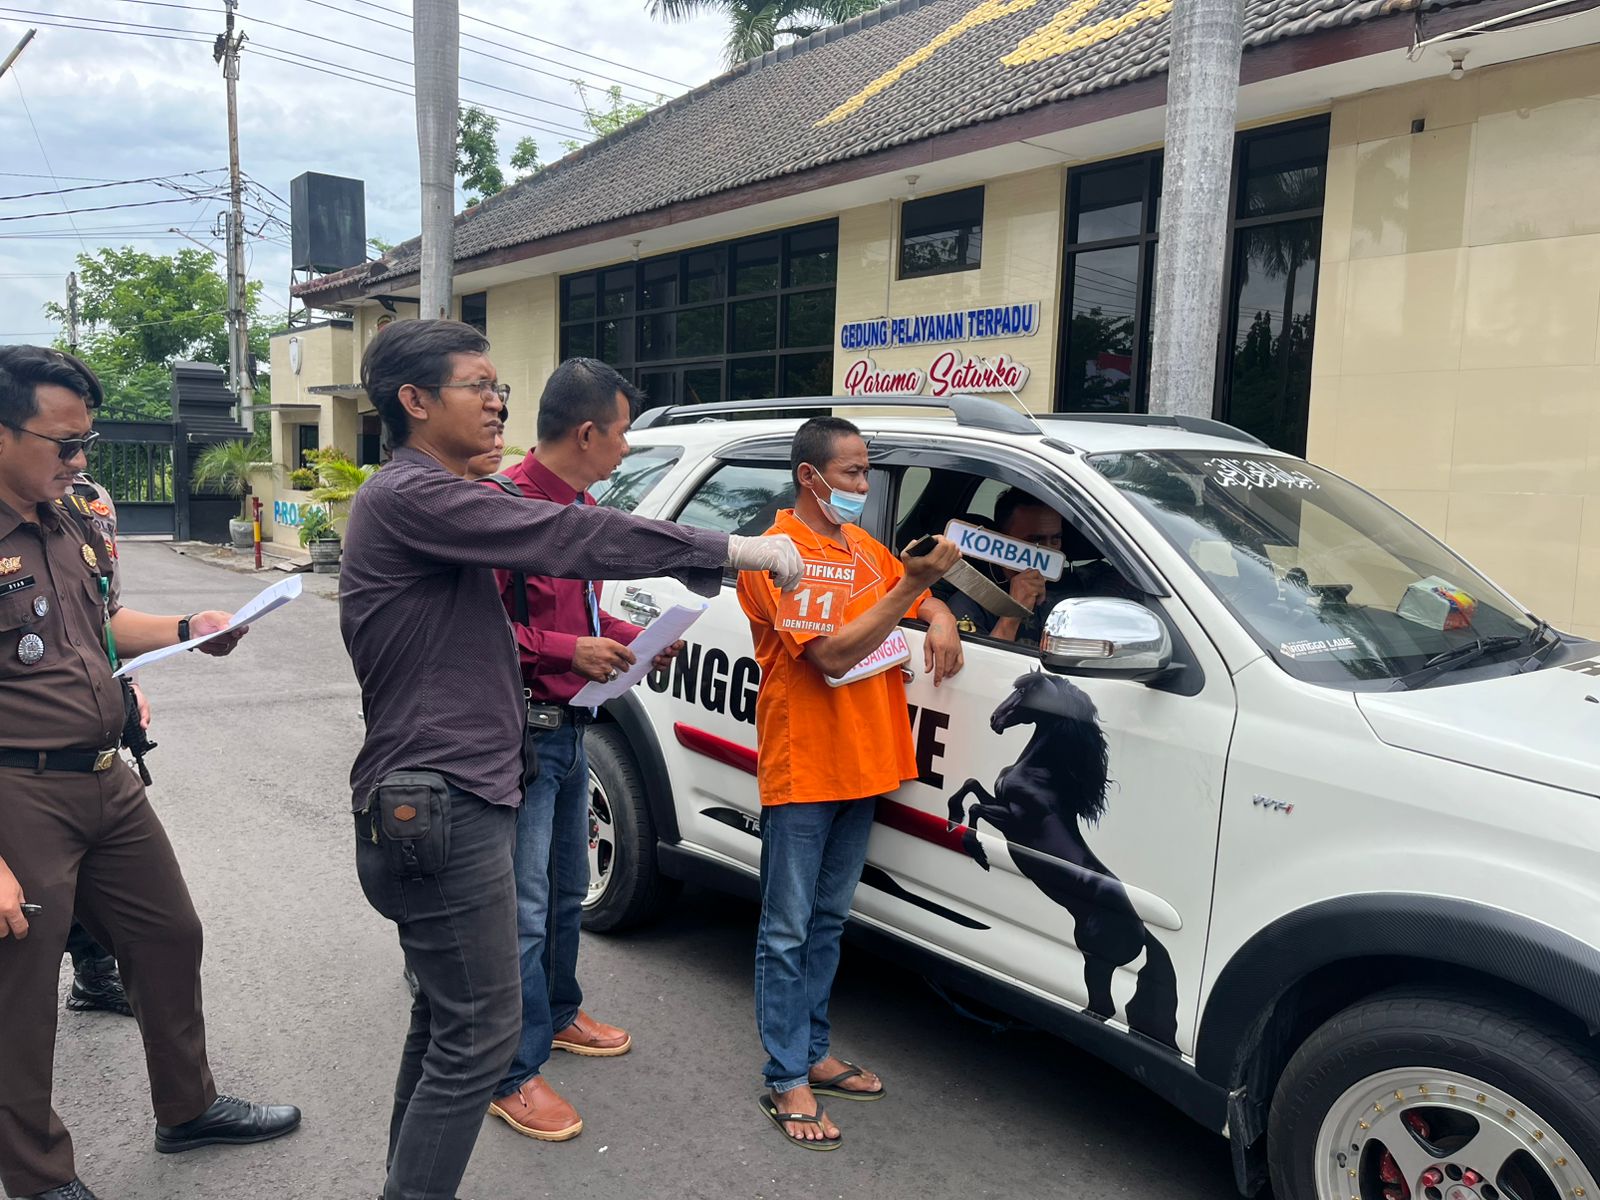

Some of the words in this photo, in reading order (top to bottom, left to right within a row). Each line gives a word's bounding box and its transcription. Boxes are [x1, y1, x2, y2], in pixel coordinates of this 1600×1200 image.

[841, 320, 888, 348] GEDUNG
[891, 312, 963, 344] PELAYANAN
[967, 304, 1033, 337] TERPADU
[845, 360, 920, 396] Parama
[960, 529, 1050, 571] KORBAN
[793, 588, 834, 620] 11
[782, 618, 835, 632] IDENTIFIKASI
